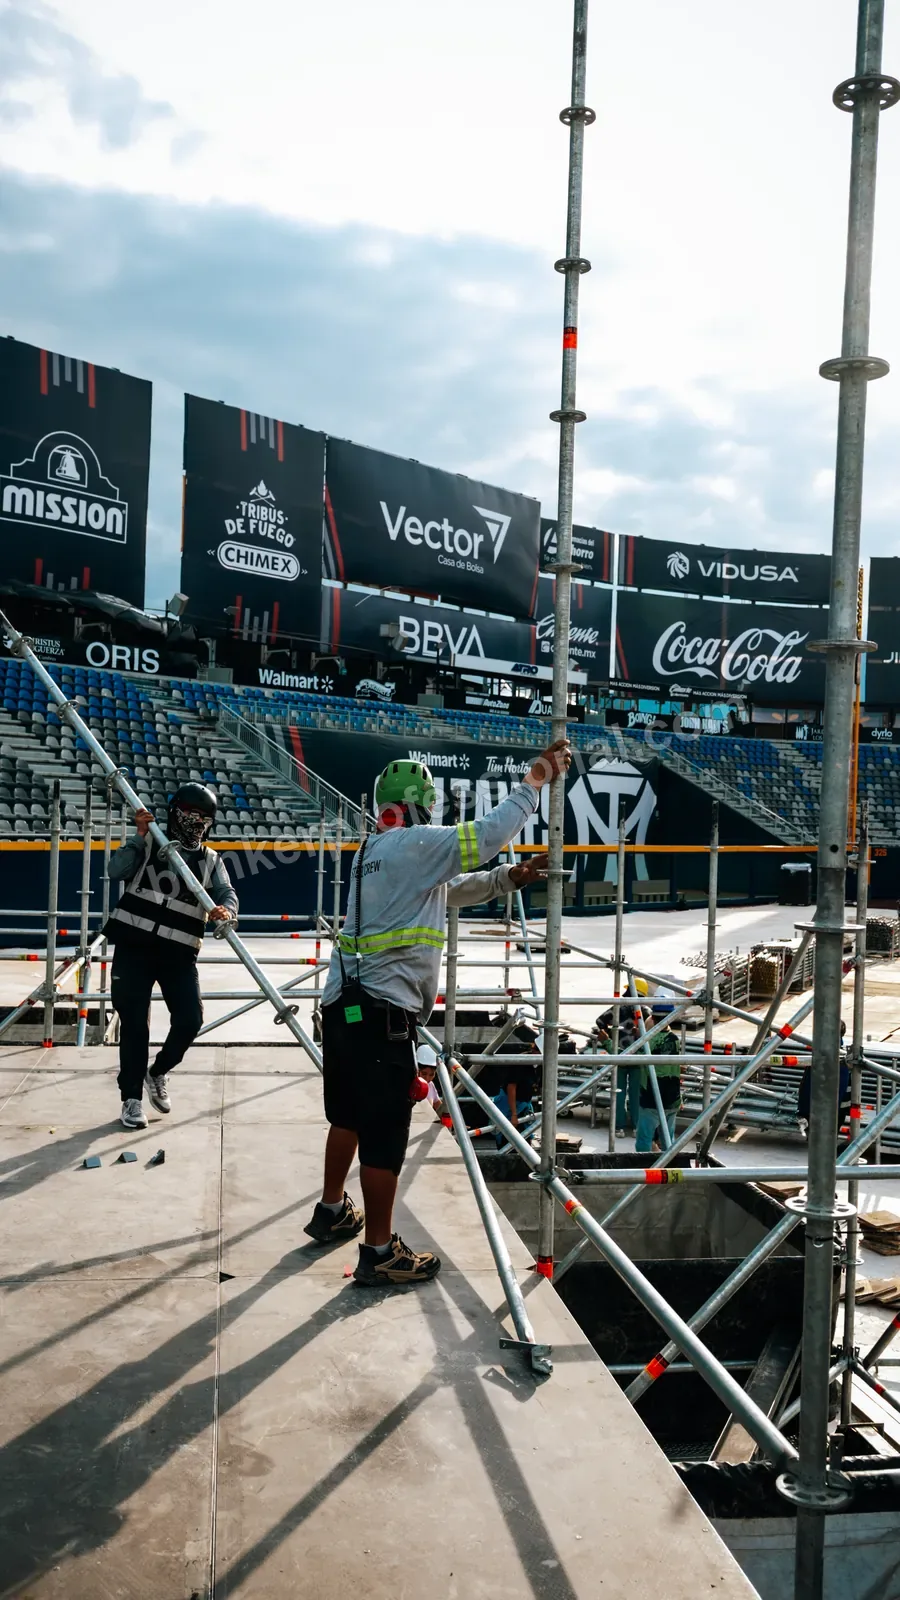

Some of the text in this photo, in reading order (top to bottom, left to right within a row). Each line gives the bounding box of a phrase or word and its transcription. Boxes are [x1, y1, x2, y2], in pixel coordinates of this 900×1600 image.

[240, 501, 284, 525] TRIBUS
[224, 518, 294, 548] DE FUEGO
[379, 500, 484, 560] Vector
[224, 547, 292, 574] CHIMEX
[437, 554, 484, 574] Casa de Bolsa
[571, 544, 594, 560] horro
[697, 560, 799, 583] VIDUSA
[399, 615, 485, 659] BBVA
[536, 613, 599, 644] Caente
[85, 641, 160, 674] ORIS
[258, 668, 319, 691] Walmart
[408, 750, 458, 768] Walmart
[486, 754, 532, 774] Tim Horto
